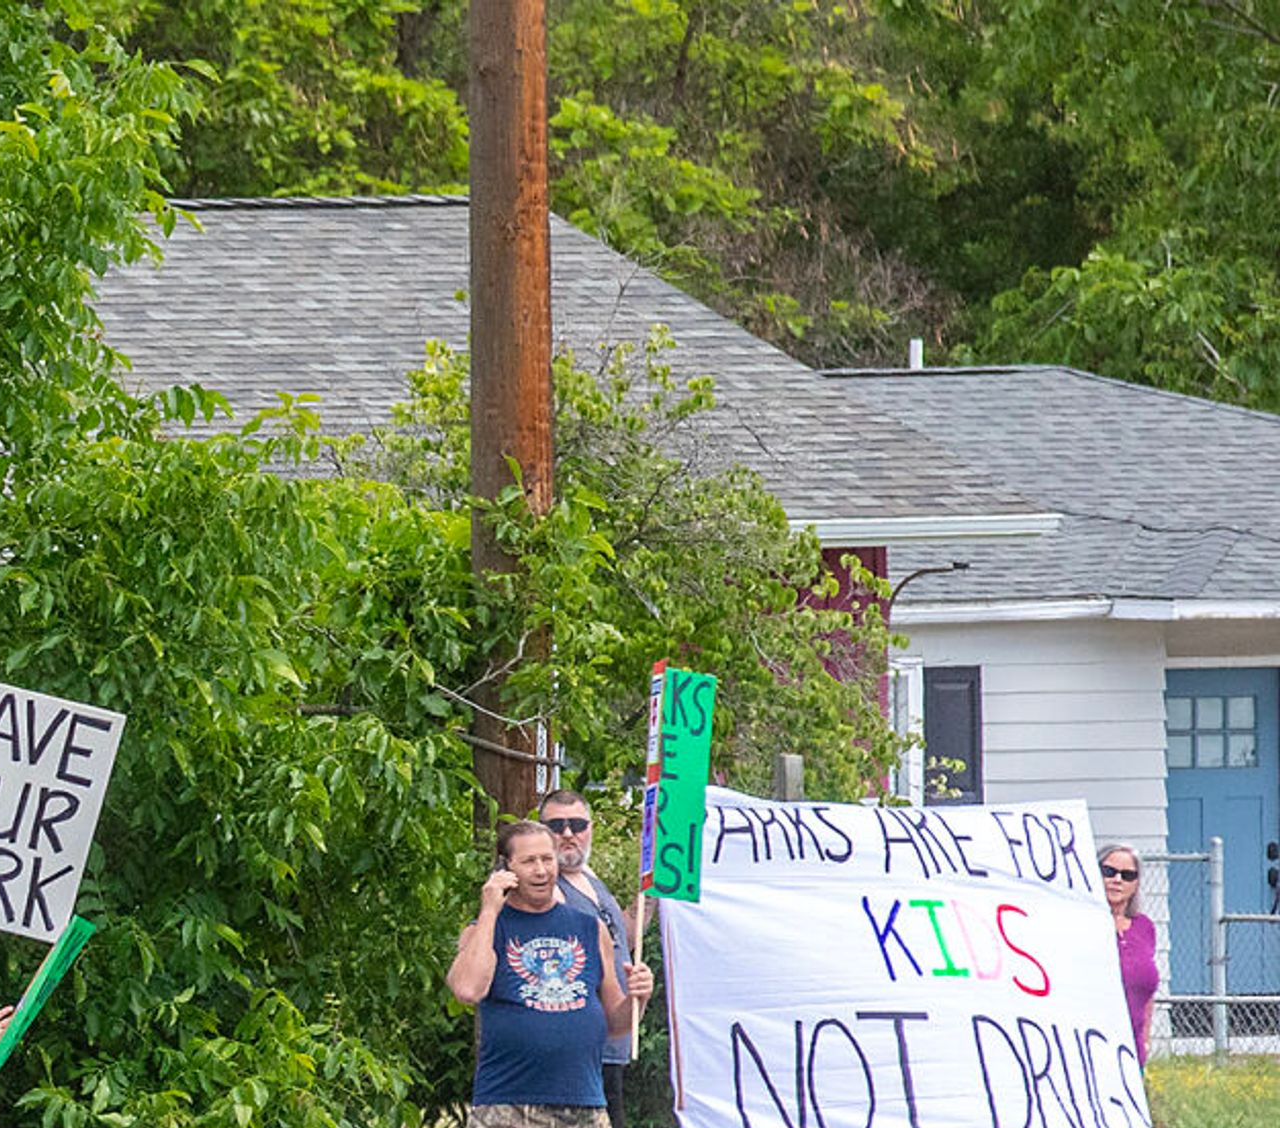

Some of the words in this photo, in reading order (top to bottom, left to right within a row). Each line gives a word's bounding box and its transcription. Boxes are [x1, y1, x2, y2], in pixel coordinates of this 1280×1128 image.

[703, 803, 853, 864] ARKS
[873, 808, 989, 880] ARE
[991, 810, 1093, 893] FOR
[862, 896, 1051, 998] KIDS
